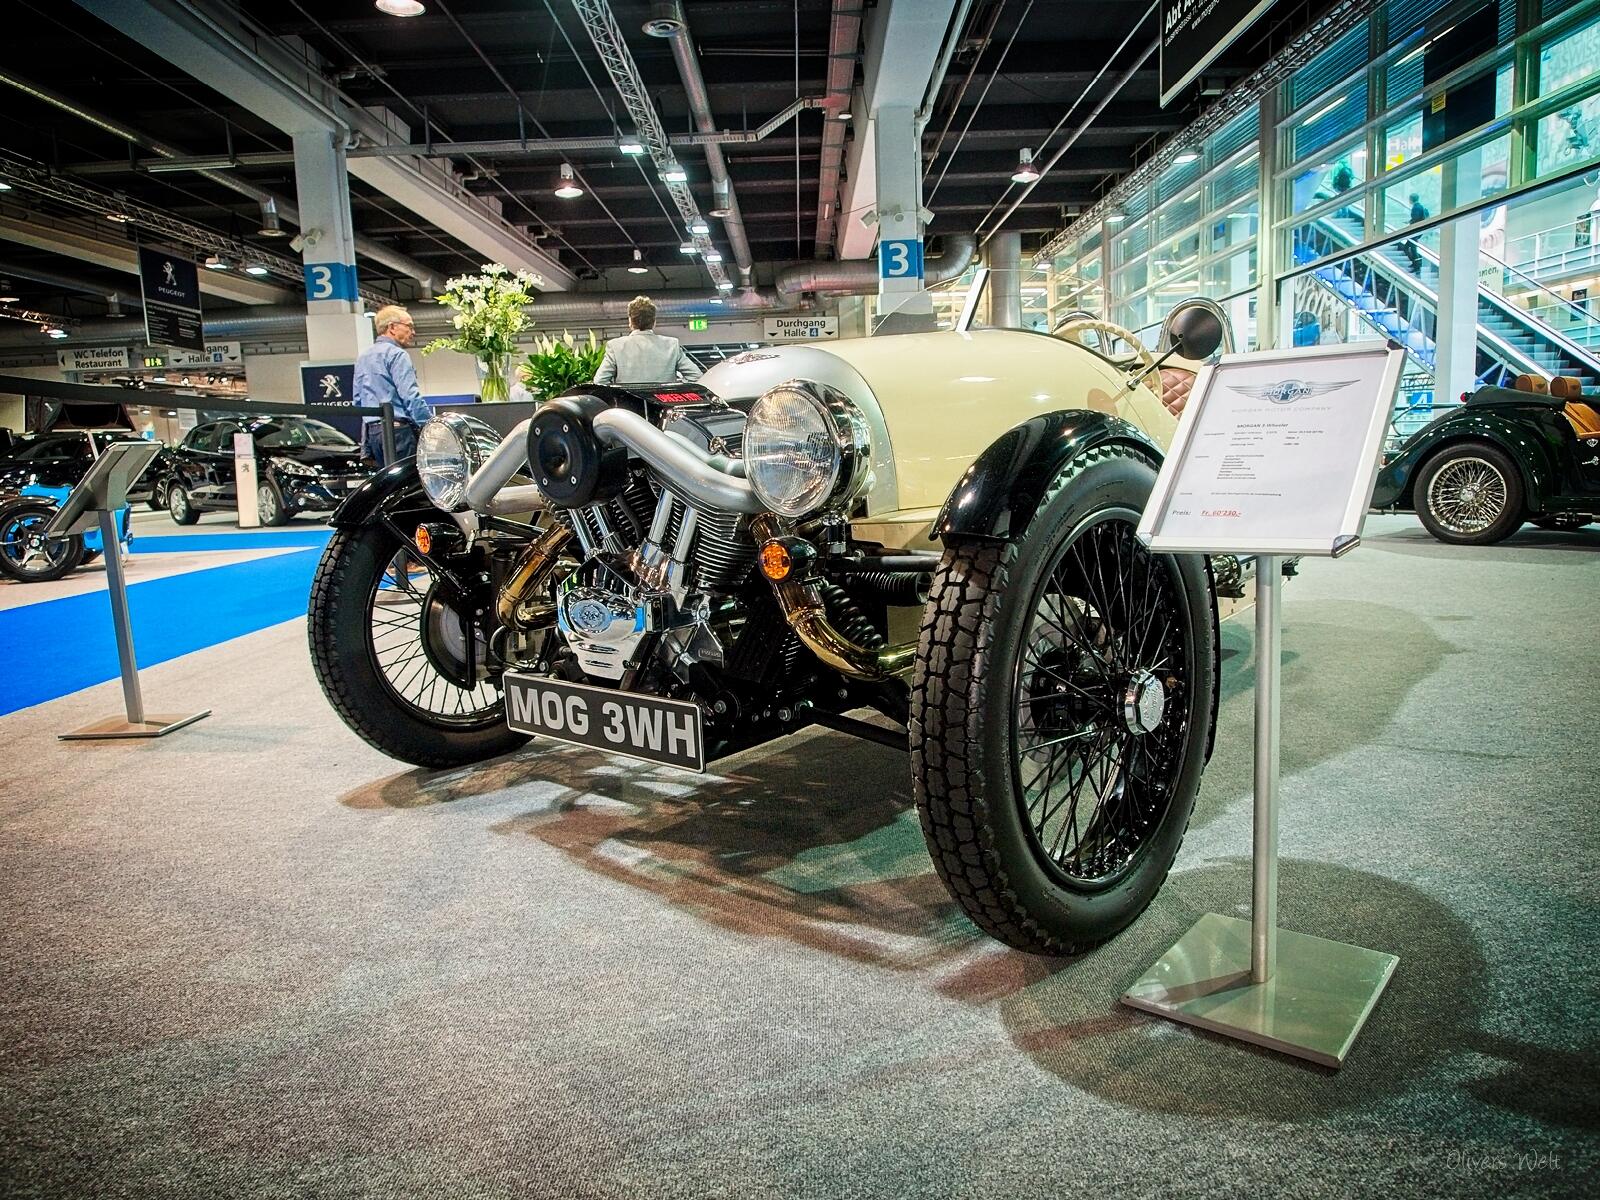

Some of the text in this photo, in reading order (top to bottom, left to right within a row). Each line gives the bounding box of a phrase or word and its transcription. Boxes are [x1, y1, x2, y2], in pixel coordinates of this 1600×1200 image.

[888, 243, 909, 276] 3
[312, 266, 332, 298] 3
[158, 286, 185, 298] PEUGEOT
[776, 319, 826, 329] Durchgang
[784, 329, 807, 337] Halle
[73, 350, 124, 359] WC Telefon
[188, 355, 211, 364] Halle
[75, 359, 122, 369] Restaurant
[1263, 386, 1313, 397] MORGAN
[510, 684, 696, 758] MOG 3WH
